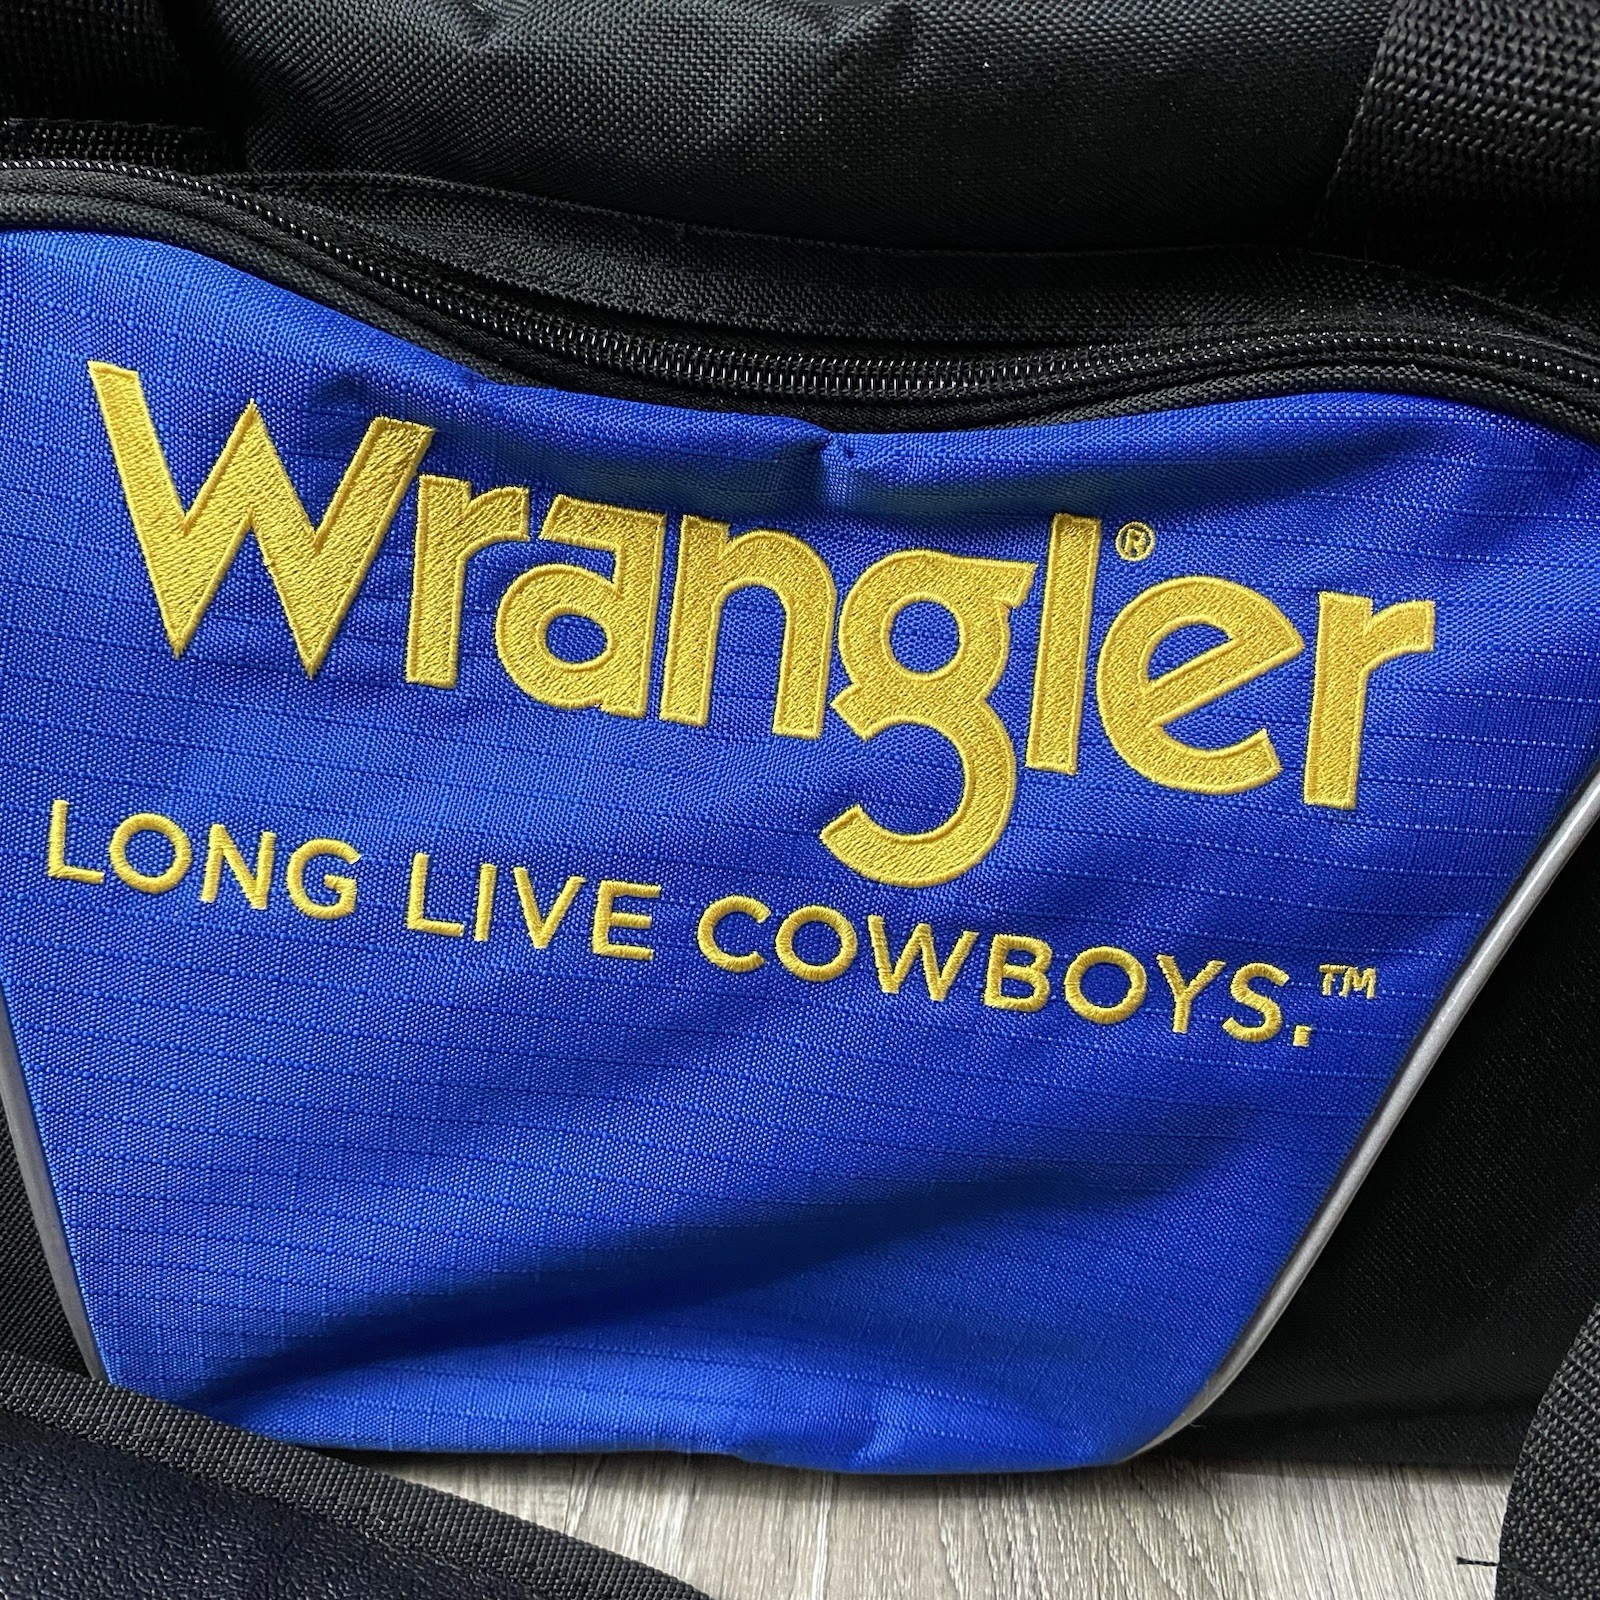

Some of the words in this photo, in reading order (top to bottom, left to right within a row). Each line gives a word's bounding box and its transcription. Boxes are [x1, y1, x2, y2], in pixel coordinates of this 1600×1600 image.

[88, 360, 1435, 888] Wrangler
[47, 800, 359, 919] LONG
[406, 853, 661, 961] LIVE
